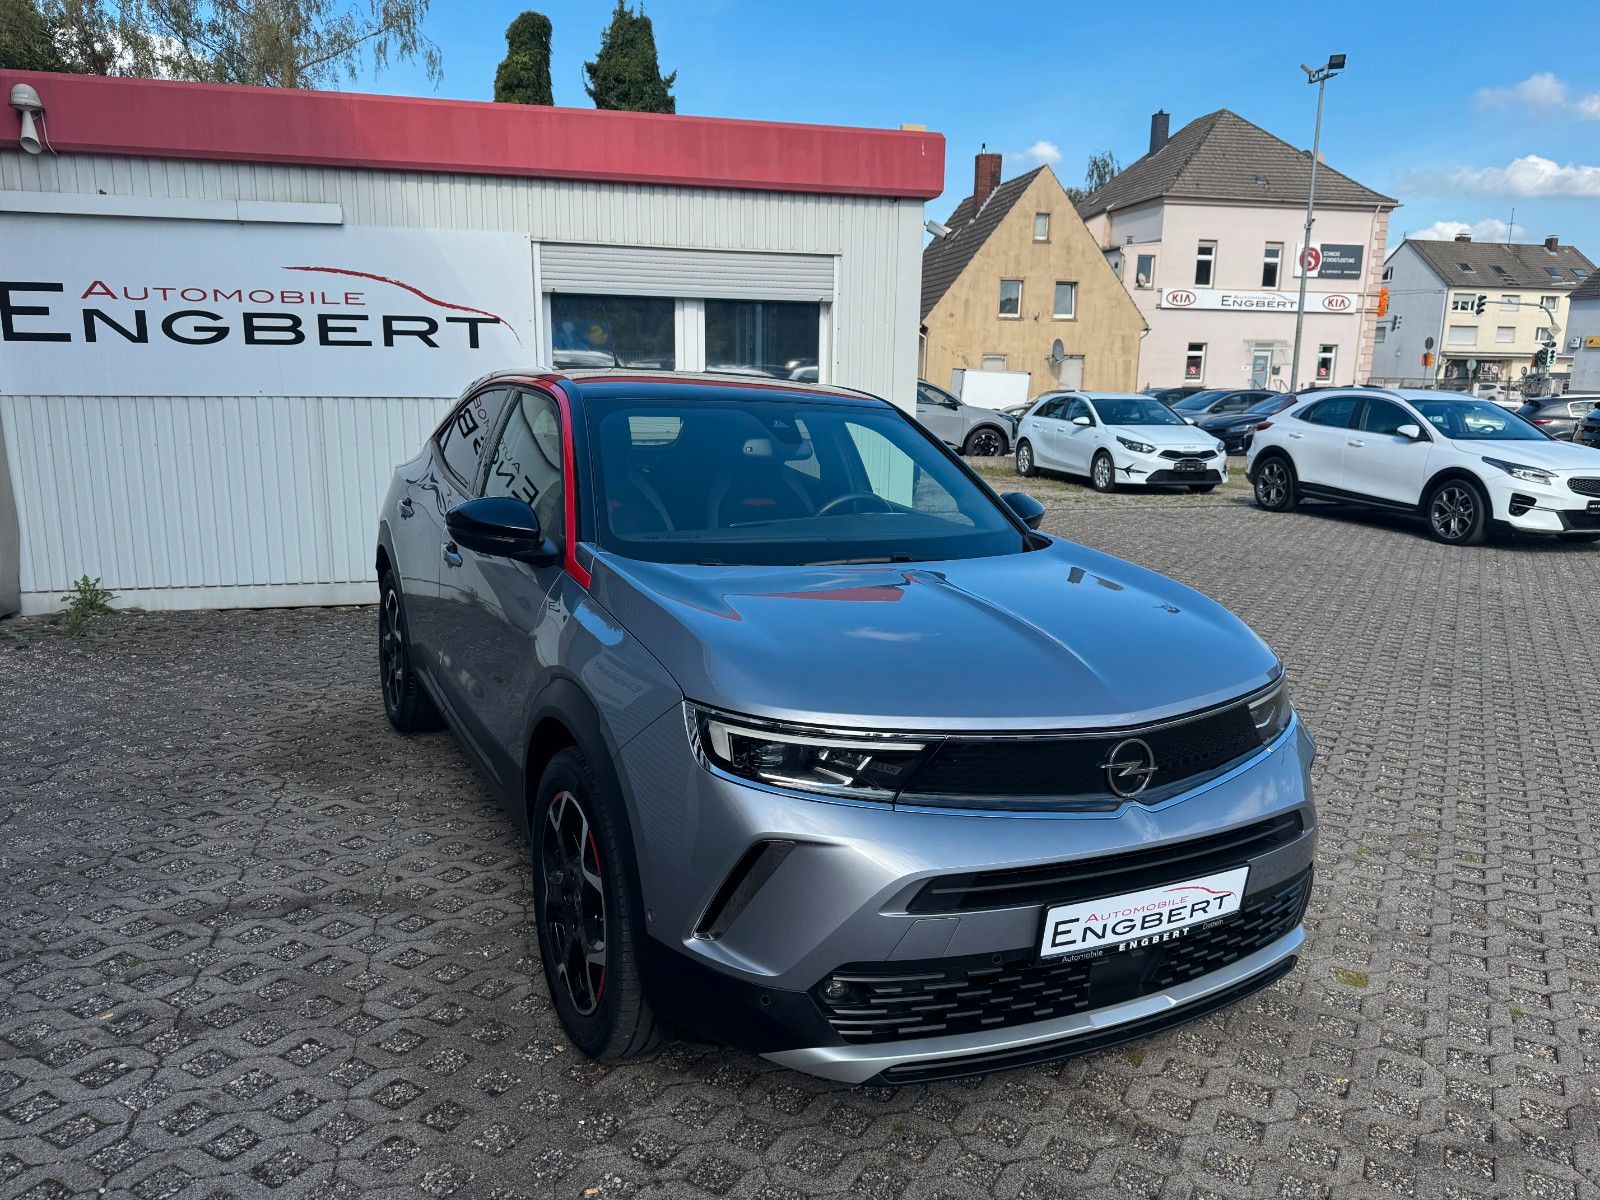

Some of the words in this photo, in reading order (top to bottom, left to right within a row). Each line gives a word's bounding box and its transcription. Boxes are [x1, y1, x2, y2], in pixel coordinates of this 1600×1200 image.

[81, 280, 366, 307] AUTOMOBILE
[1171, 293, 1191, 303] KIA
[1221, 295, 1297, 309] ENGBERT
[1327, 298, 1346, 308] KIA
[0, 281, 501, 349] ENGBERT
[1050, 894, 1232, 948] ENGBERT
[1085, 896, 1189, 924] AUTOMOBILE
[1118, 927, 1190, 952] ENGBERT
[1061, 949, 1104, 963] Automobile
